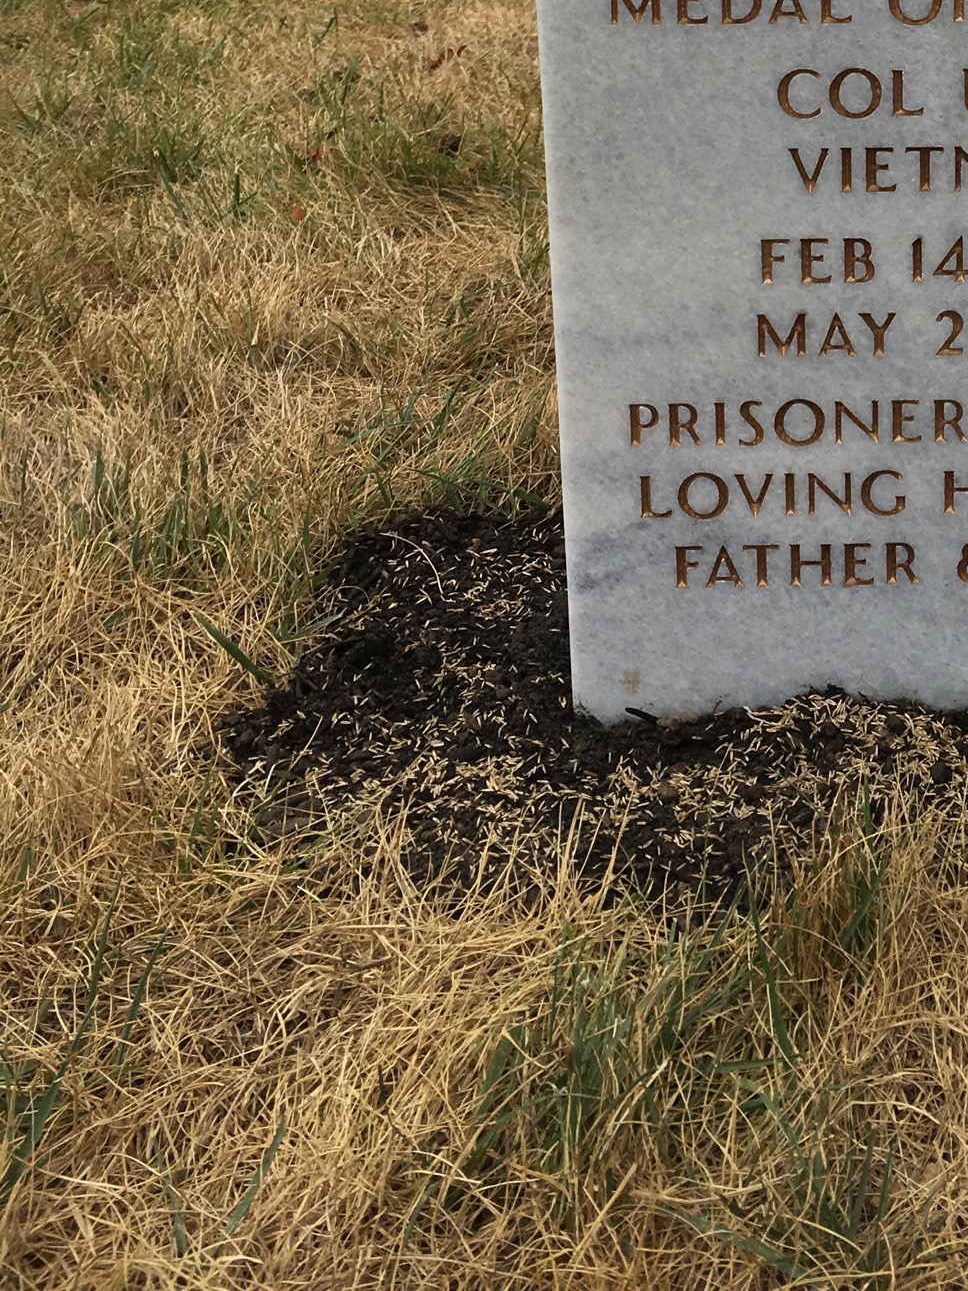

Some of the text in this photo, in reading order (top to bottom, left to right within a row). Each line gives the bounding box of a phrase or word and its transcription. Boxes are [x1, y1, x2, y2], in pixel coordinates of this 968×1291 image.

[776, 68, 925, 120] COL
[760, 236, 877, 285] FEB
[756, 311, 898, 358] MAY
[934, 310, 965, 356] 2
[639, 468, 907, 521] LOVING
[674, 542, 921, 590] FATHER
